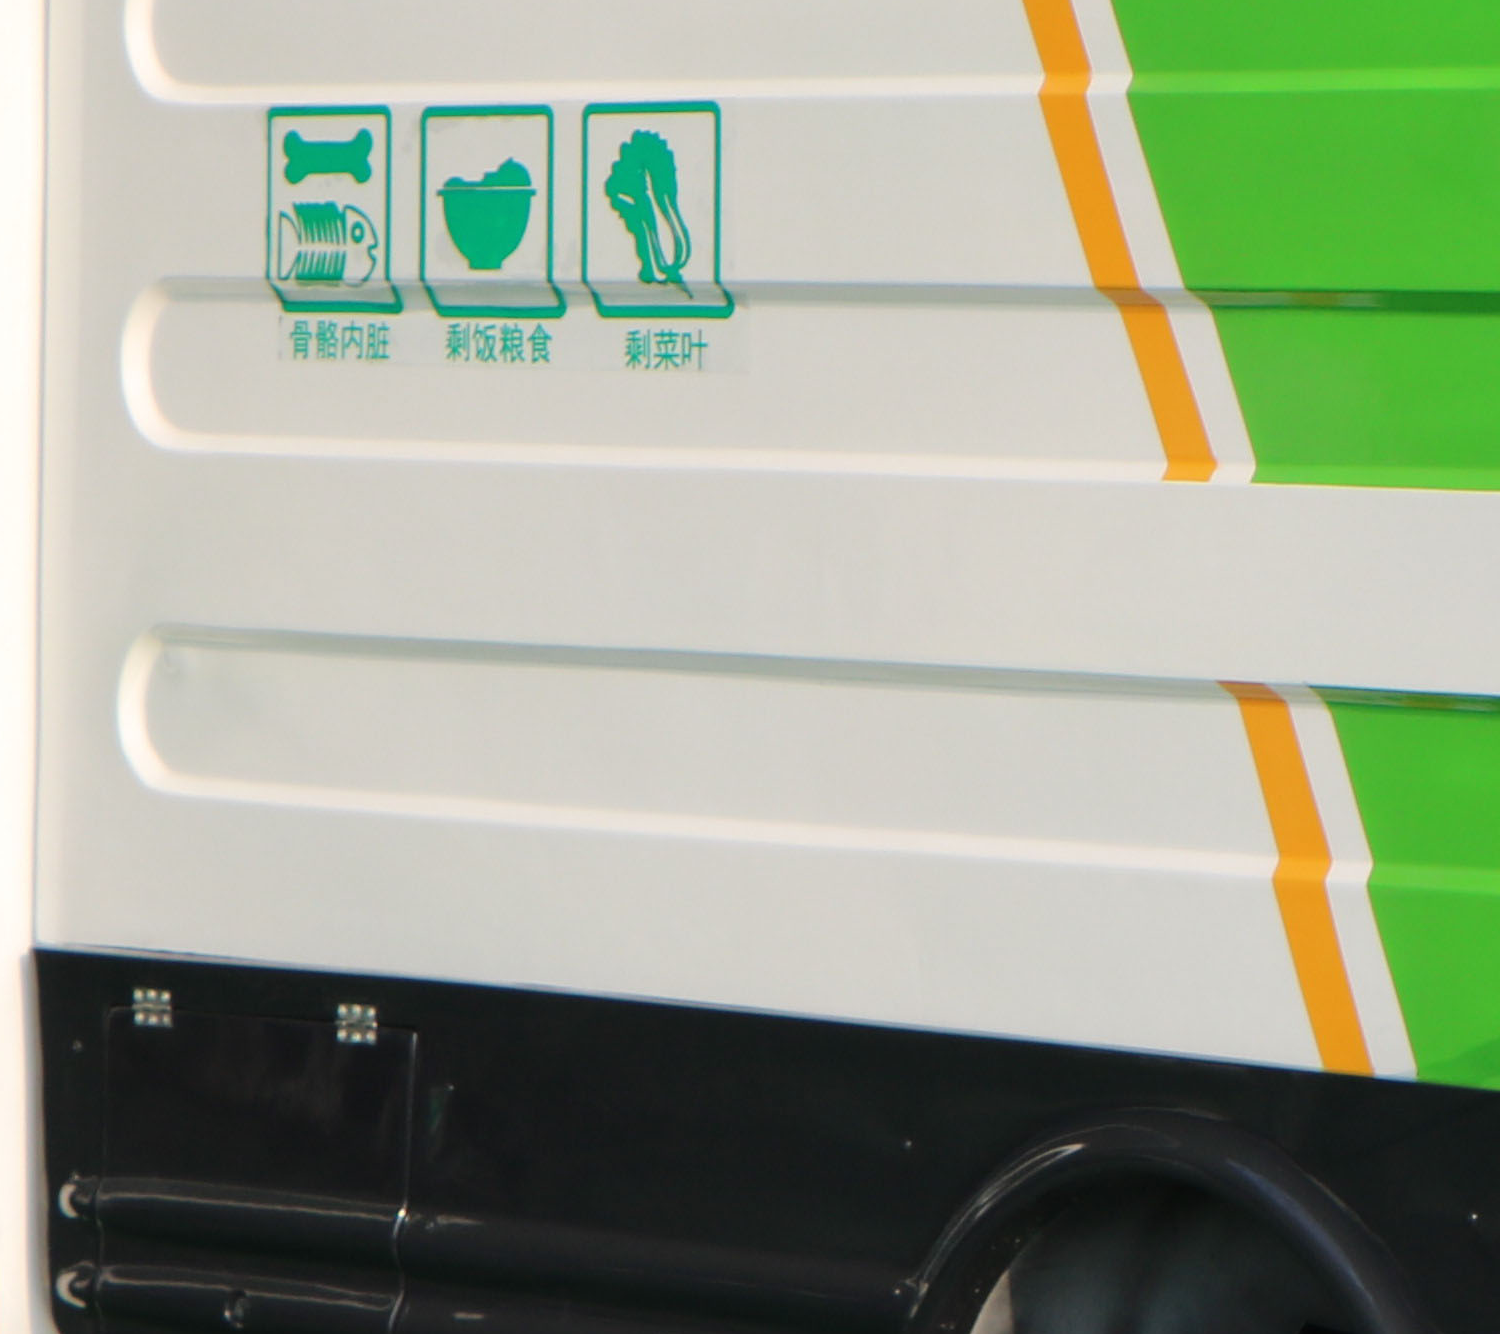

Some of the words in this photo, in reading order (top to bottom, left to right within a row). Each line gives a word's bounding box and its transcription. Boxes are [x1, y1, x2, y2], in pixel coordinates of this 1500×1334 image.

[288, 320, 391, 361] 骨骼内脏
[444, 323, 554, 364] 剩饭粮食
[624, 328, 710, 371] 剩菜叶
